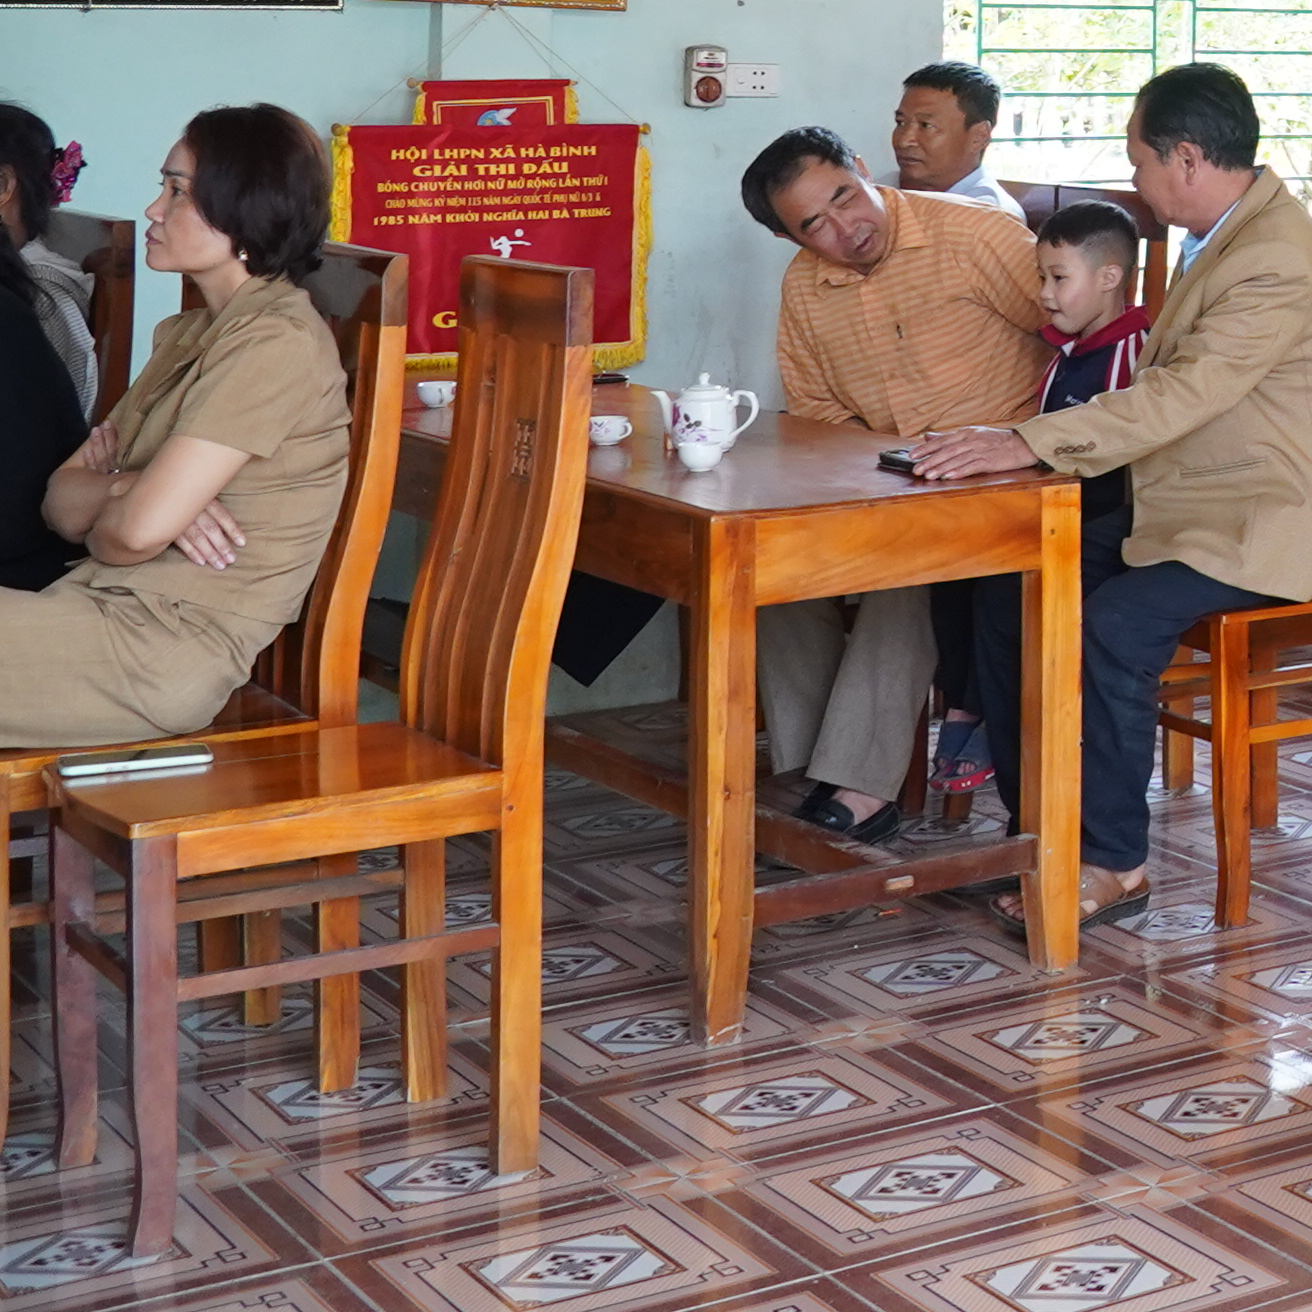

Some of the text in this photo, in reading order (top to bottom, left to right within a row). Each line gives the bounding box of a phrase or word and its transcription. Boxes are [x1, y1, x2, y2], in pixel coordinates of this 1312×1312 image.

[391, 143, 597, 163] HỘI LHPN XÃ HÀ BÌNH
[412, 158, 569, 177] GIẢI THI ĐẤU
[377, 179, 409, 193] BÓNG
[487, 177, 505, 190] NỮ
[526, 176, 557, 191] RỘNG
[582, 174, 604, 186] THỨ
[373, 206, 611, 226] 1985 NĂM KHỞI NGHĨA HAI BÀ TRUNG
